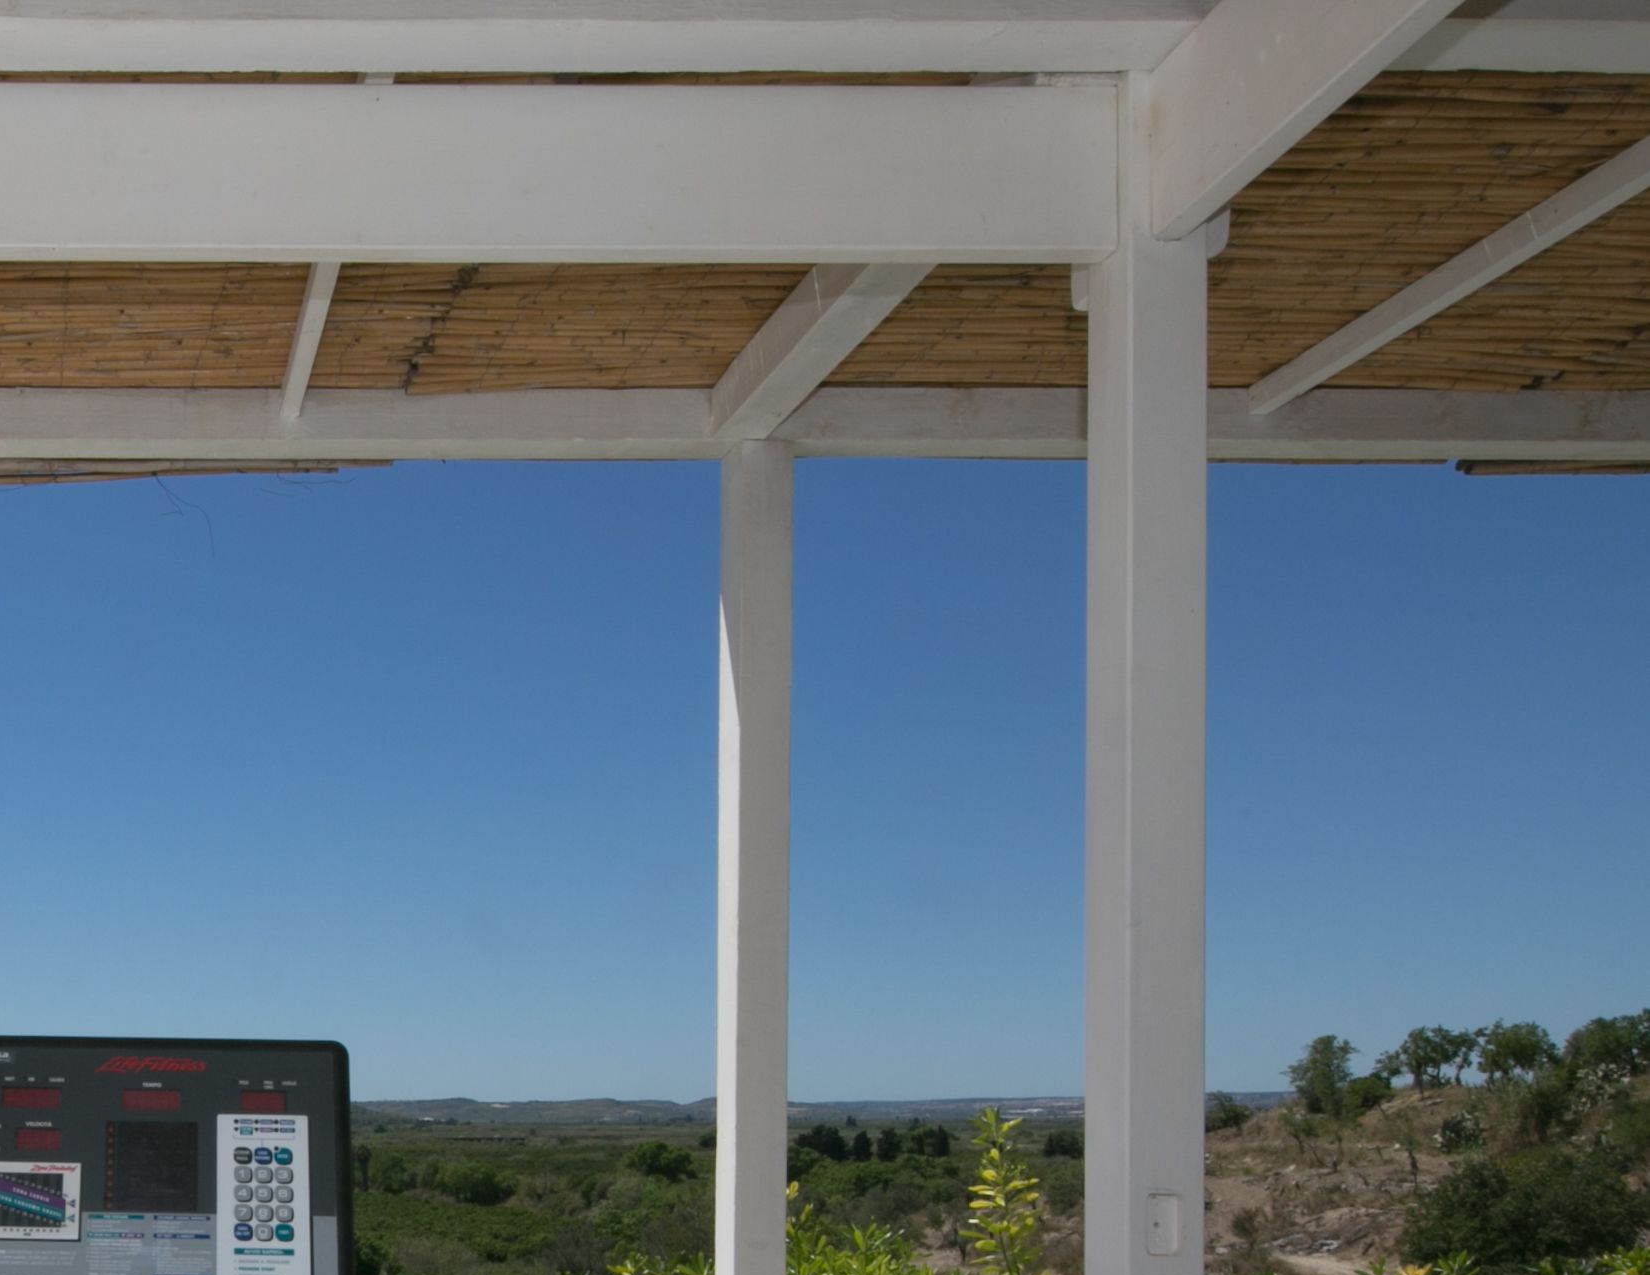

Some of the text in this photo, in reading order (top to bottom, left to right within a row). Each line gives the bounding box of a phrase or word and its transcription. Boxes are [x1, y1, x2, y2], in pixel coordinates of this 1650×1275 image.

[239, 1169, 245, 1178] 1
[258, 1169, 267, 1178] 2
[278, 1170, 288, 1179] 3
[238, 1188, 247, 1197] 4
[258, 1188, 267, 1198] 5
[278, 1188, 288, 1198] 6
[238, 1207, 247, 1217] 7
[279, 1208, 288, 1218] 9
[258, 1227, 268, 1237] 0
